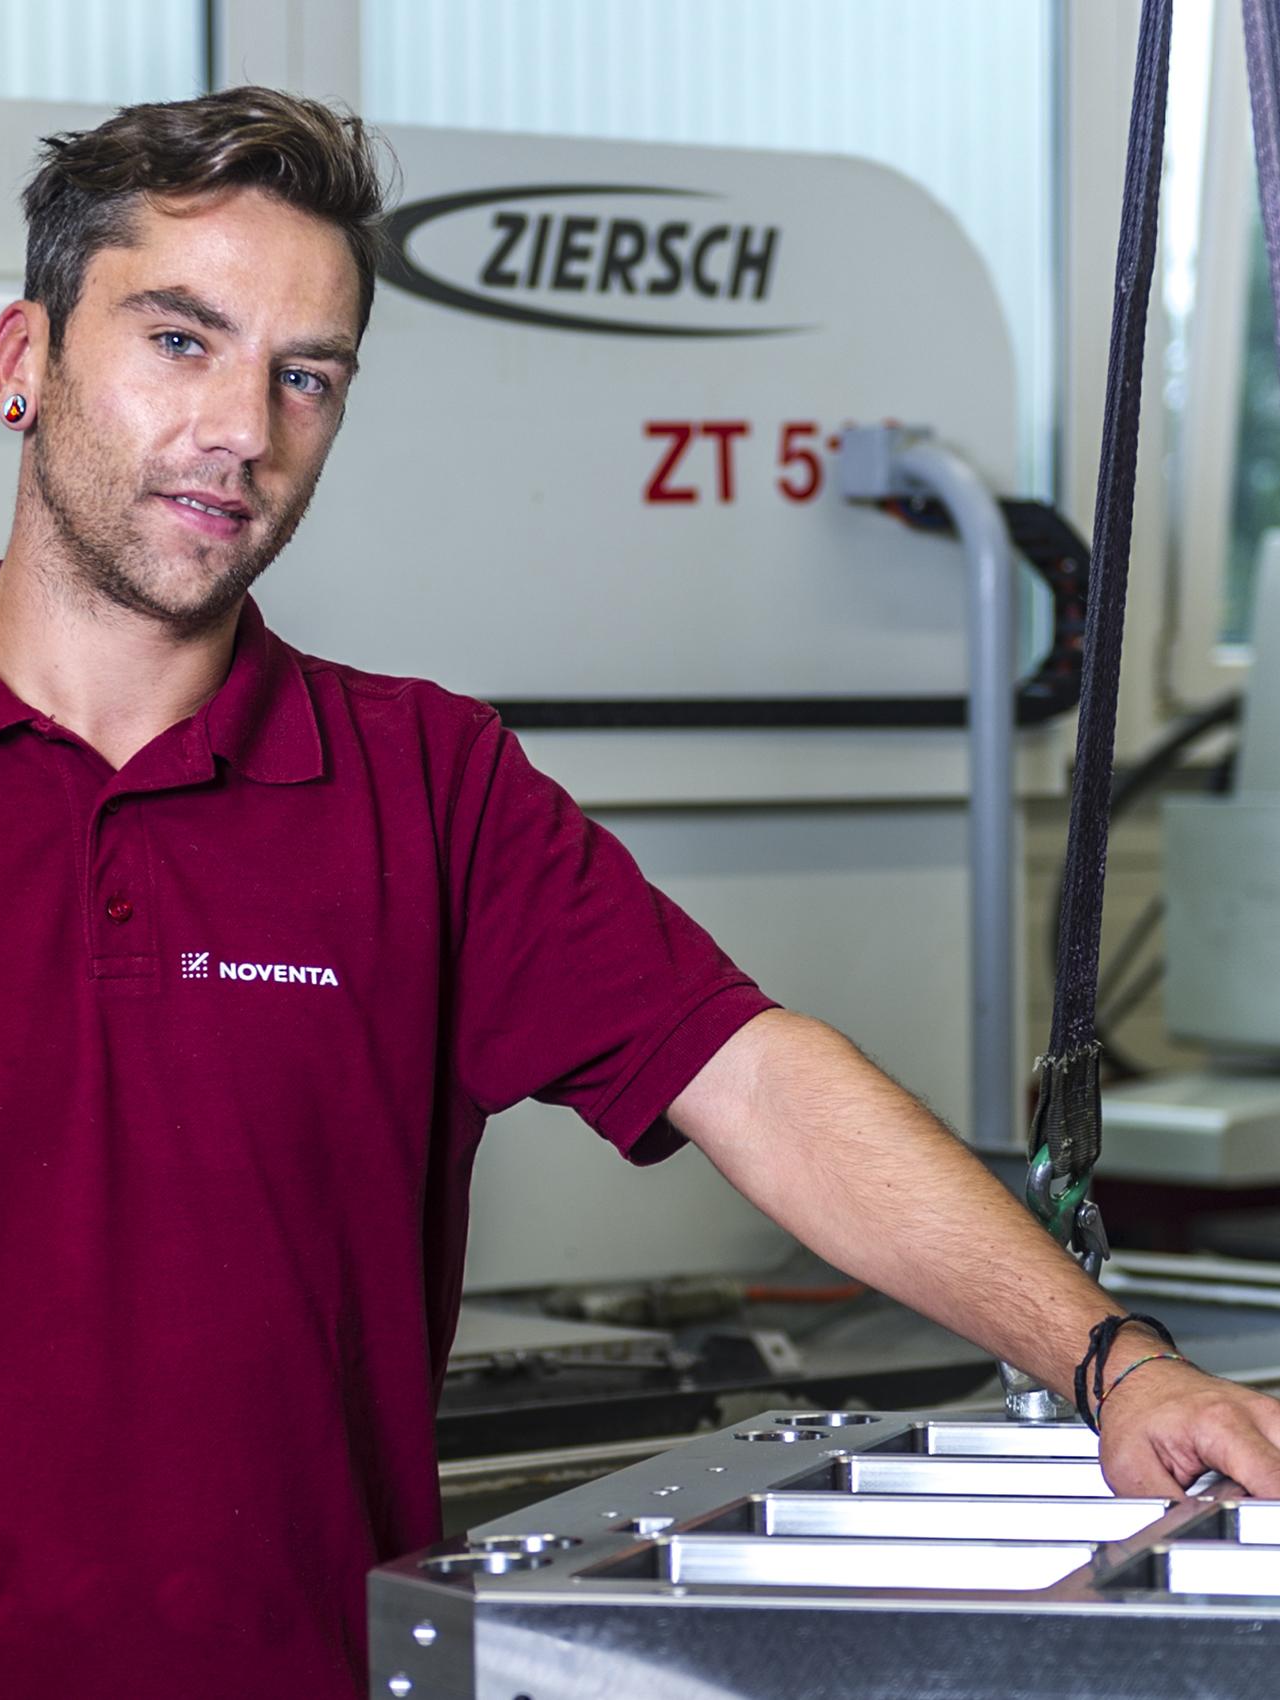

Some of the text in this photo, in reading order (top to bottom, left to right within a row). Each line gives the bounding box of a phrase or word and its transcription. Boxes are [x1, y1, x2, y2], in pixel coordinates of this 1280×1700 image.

[479, 212, 780, 301] ZIERSCH
[642, 419, 841, 505] ZT 5
[219, 961, 339, 987] NOVENTA
